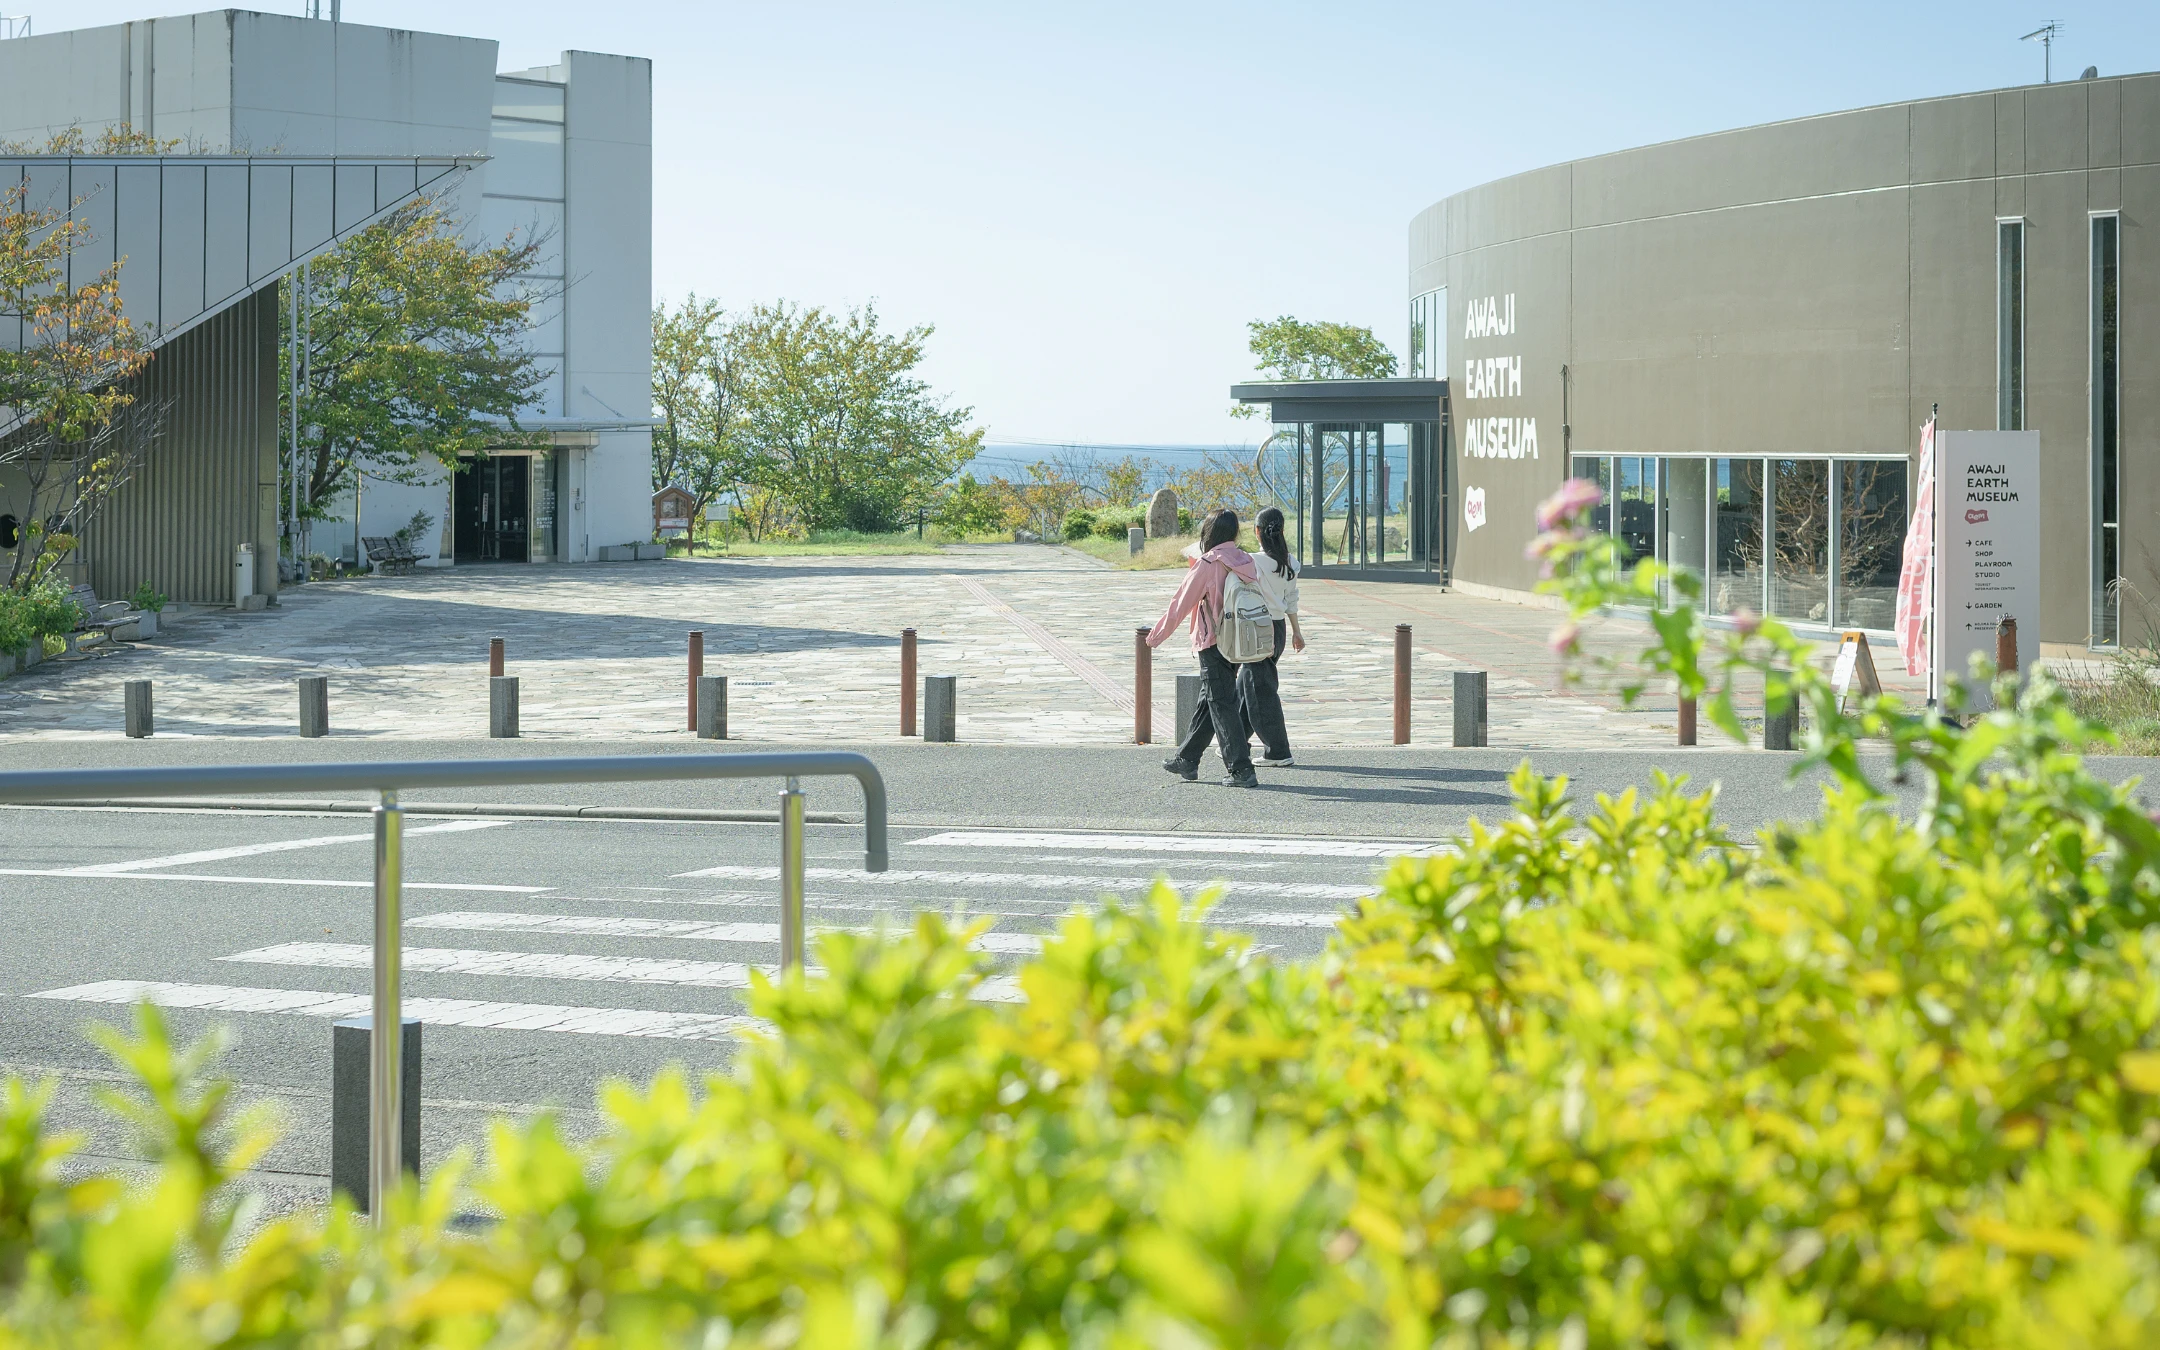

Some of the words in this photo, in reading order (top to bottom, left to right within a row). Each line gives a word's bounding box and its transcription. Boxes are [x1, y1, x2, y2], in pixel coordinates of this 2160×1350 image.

[1465, 293, 1515, 339] AWAJI
[1465, 355, 1521, 399] EARTH
[1464, 417, 1539, 460] MUSEUM
[1966, 464, 2005, 474] AWAJI
[1967, 478, 2009, 488] EARTH
[1966, 492, 2019, 502] MUSEUM
